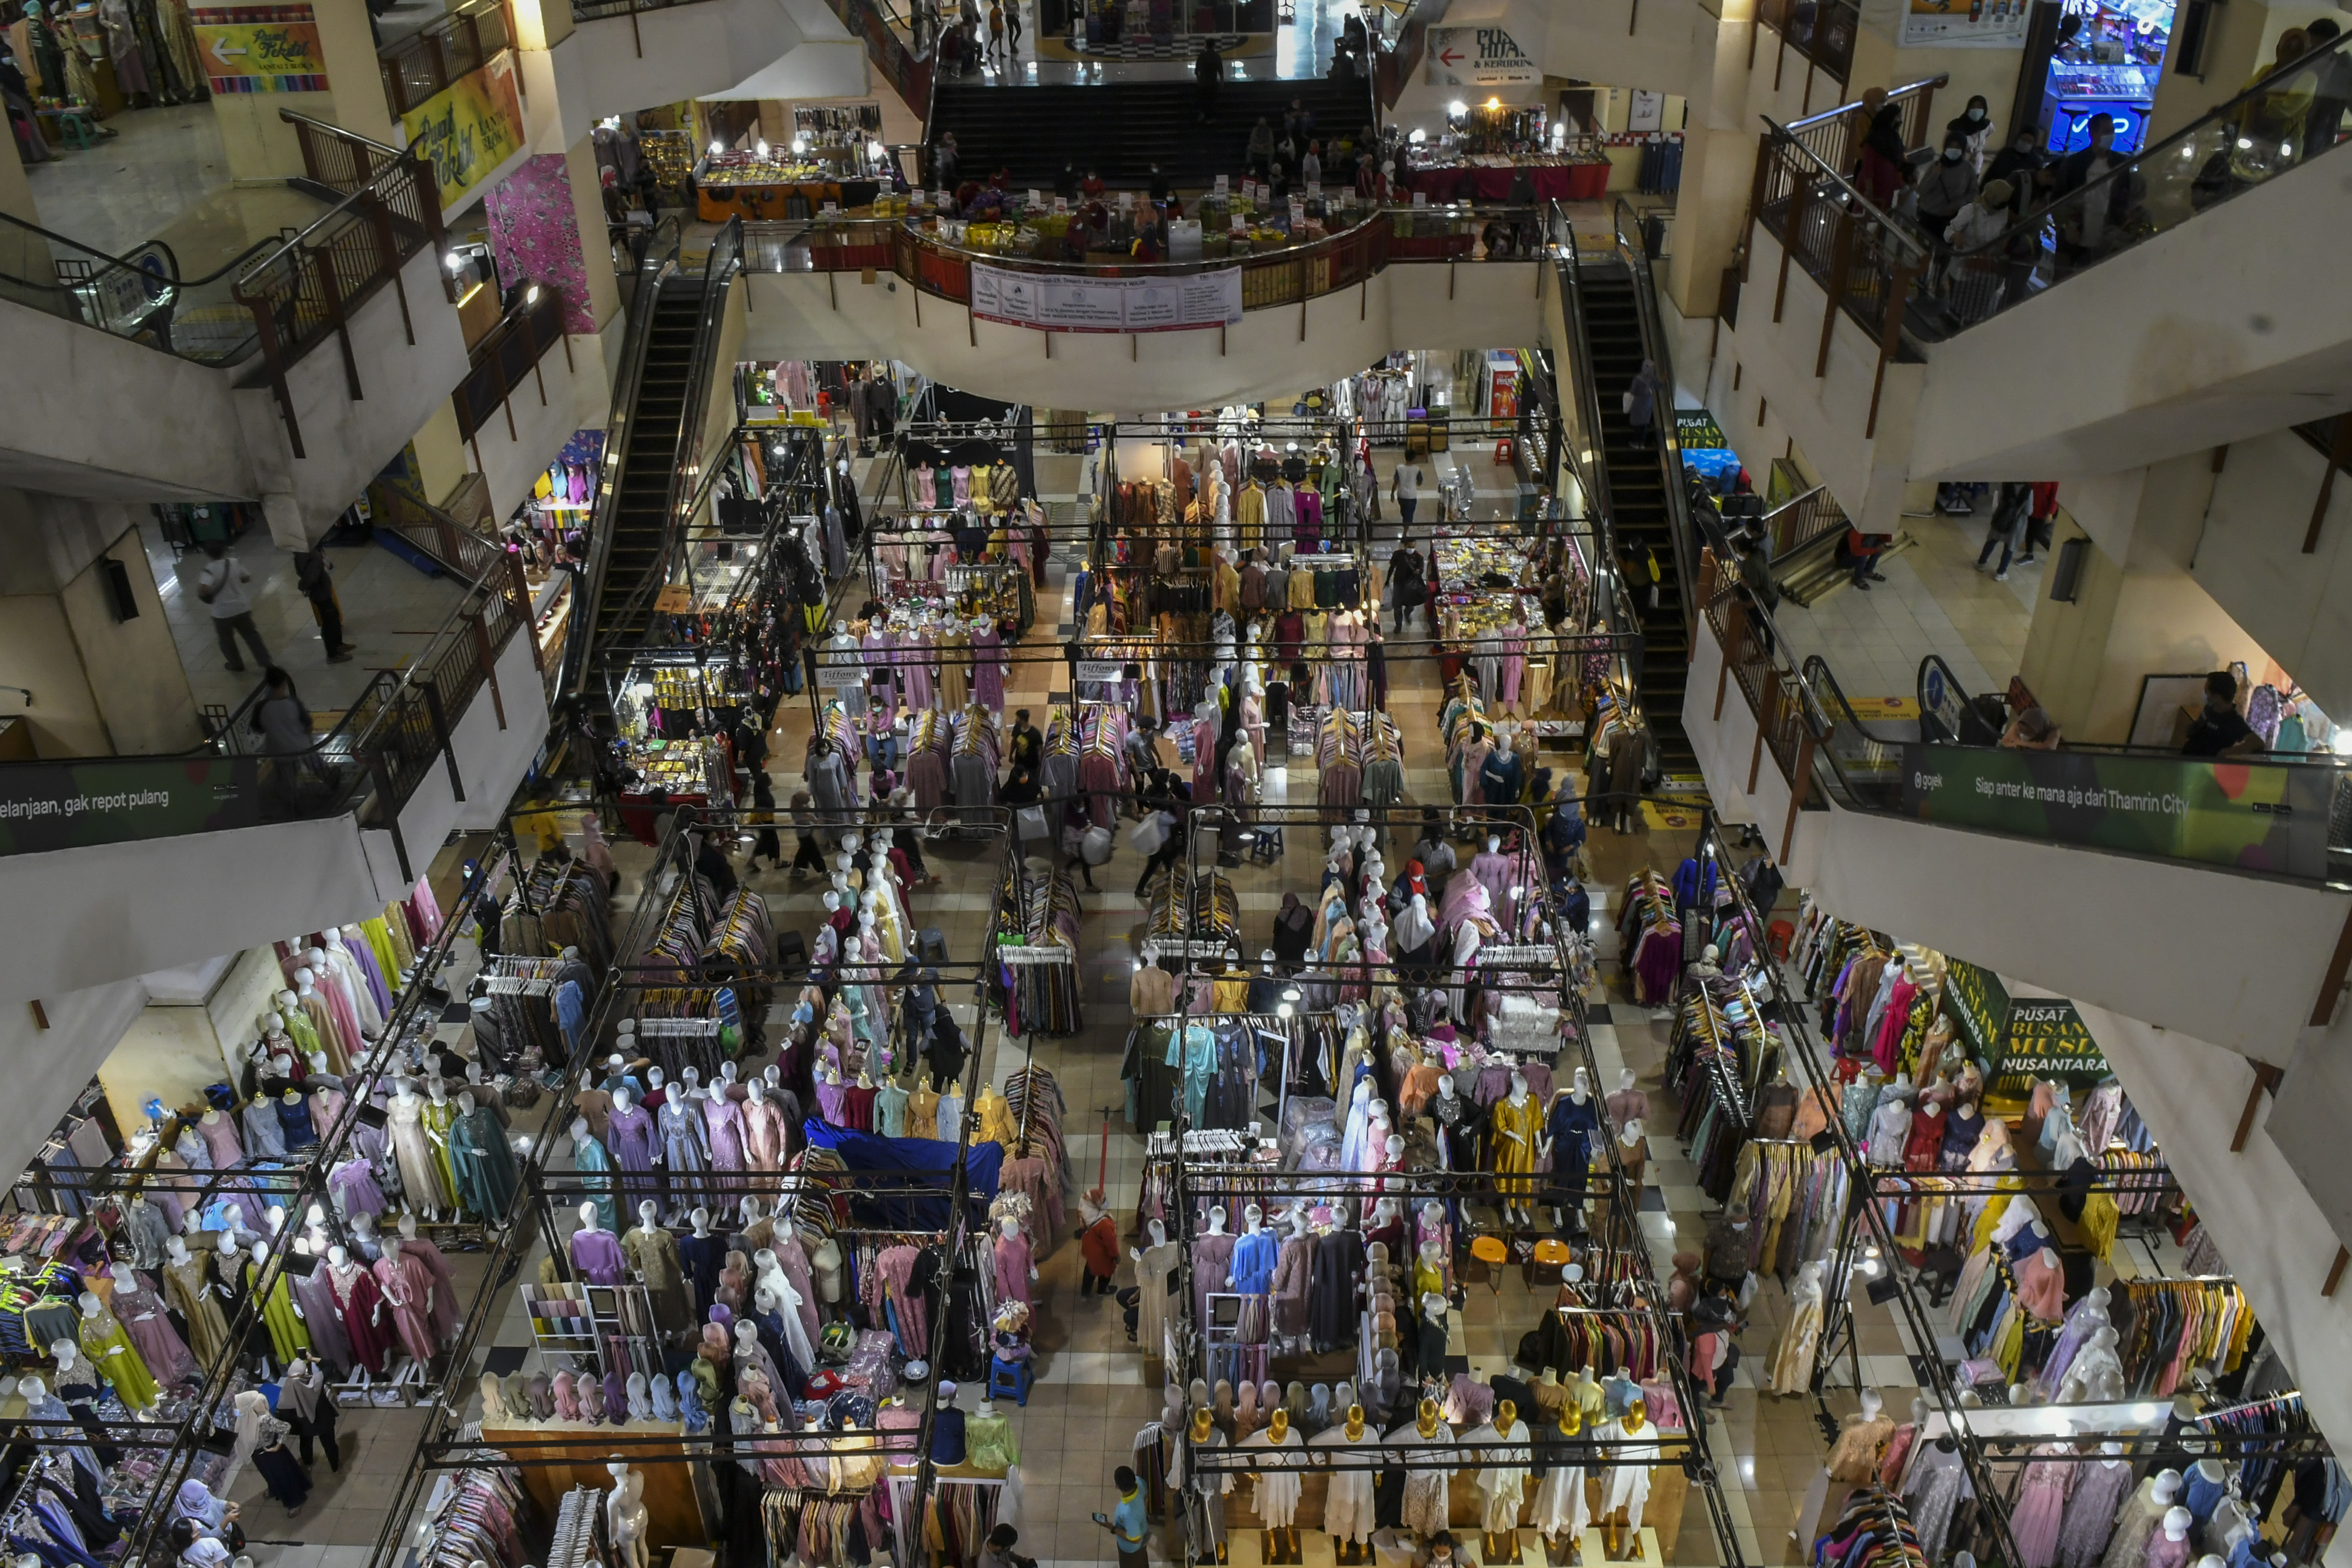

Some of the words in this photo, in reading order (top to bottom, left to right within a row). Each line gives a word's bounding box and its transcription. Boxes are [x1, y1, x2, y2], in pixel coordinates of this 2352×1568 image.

[1479, 43, 1526, 59] HIJA
[2072, 114, 2129, 133] vo
[1922, 773, 1943, 791] gojek
[0, 797, 62, 820] elanjaan,
[65, 794, 89, 817] gak
[92, 792, 126, 813] repot
[129, 789, 169, 810] pulang
[1976, 777, 1994, 798] Siap
[1996, 781, 2021, 798] anter
[2023, 781, 2034, 800] ke
[2037, 787, 2065, 803] mana
[2067, 785, 2083, 808] aja
[2085, 788, 2107, 808] dari
[2108, 790, 2160, 813] Thamrin
[2162, 791, 2190, 820] City
[1946, 974, 1983, 1049] NUSANTARA
[2014, 1009, 2067, 1021] PUSAT
[2012, 1022, 2089, 1036] BUSAN
[2006, 1038, 2102, 1055] MUSL
[2002, 1058, 2108, 1071] NUSANTARA
